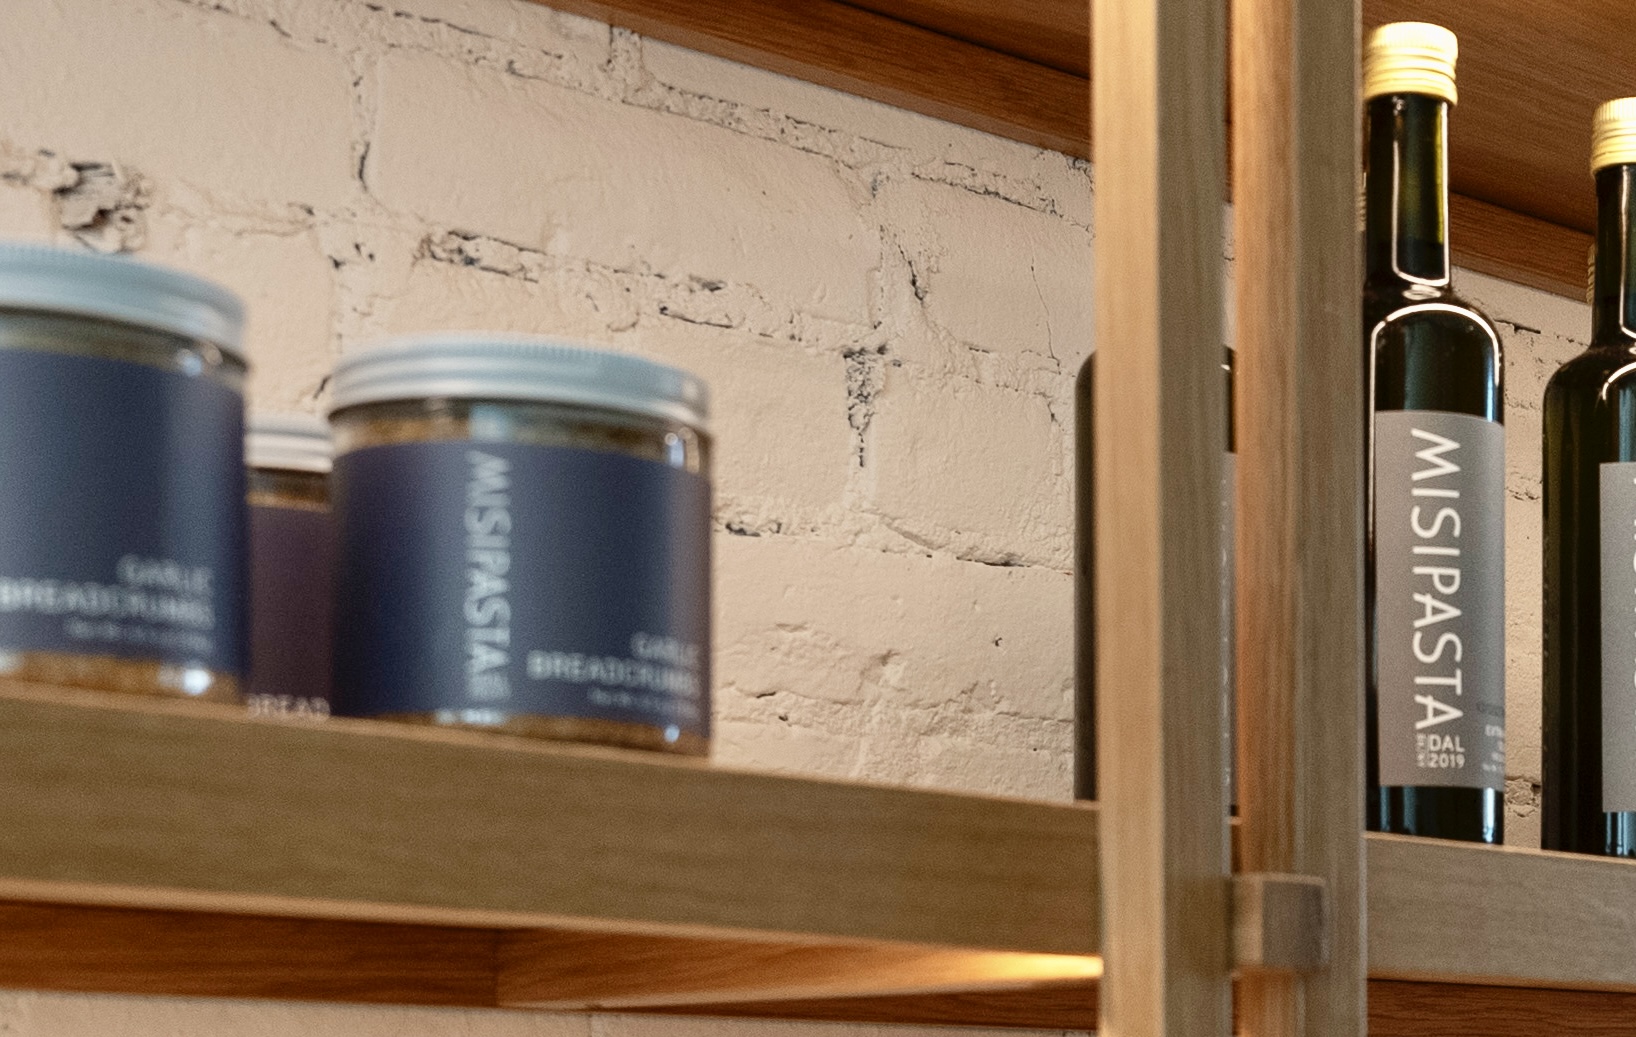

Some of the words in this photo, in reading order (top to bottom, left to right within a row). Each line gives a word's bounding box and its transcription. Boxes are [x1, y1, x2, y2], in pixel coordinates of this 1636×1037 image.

[464, 450, 512, 675] MISIPASTA
[1410, 427, 1464, 730] MISIPASTA
[1427, 752, 1466, 769] 2019
[1428, 733, 1466, 753] DAL
